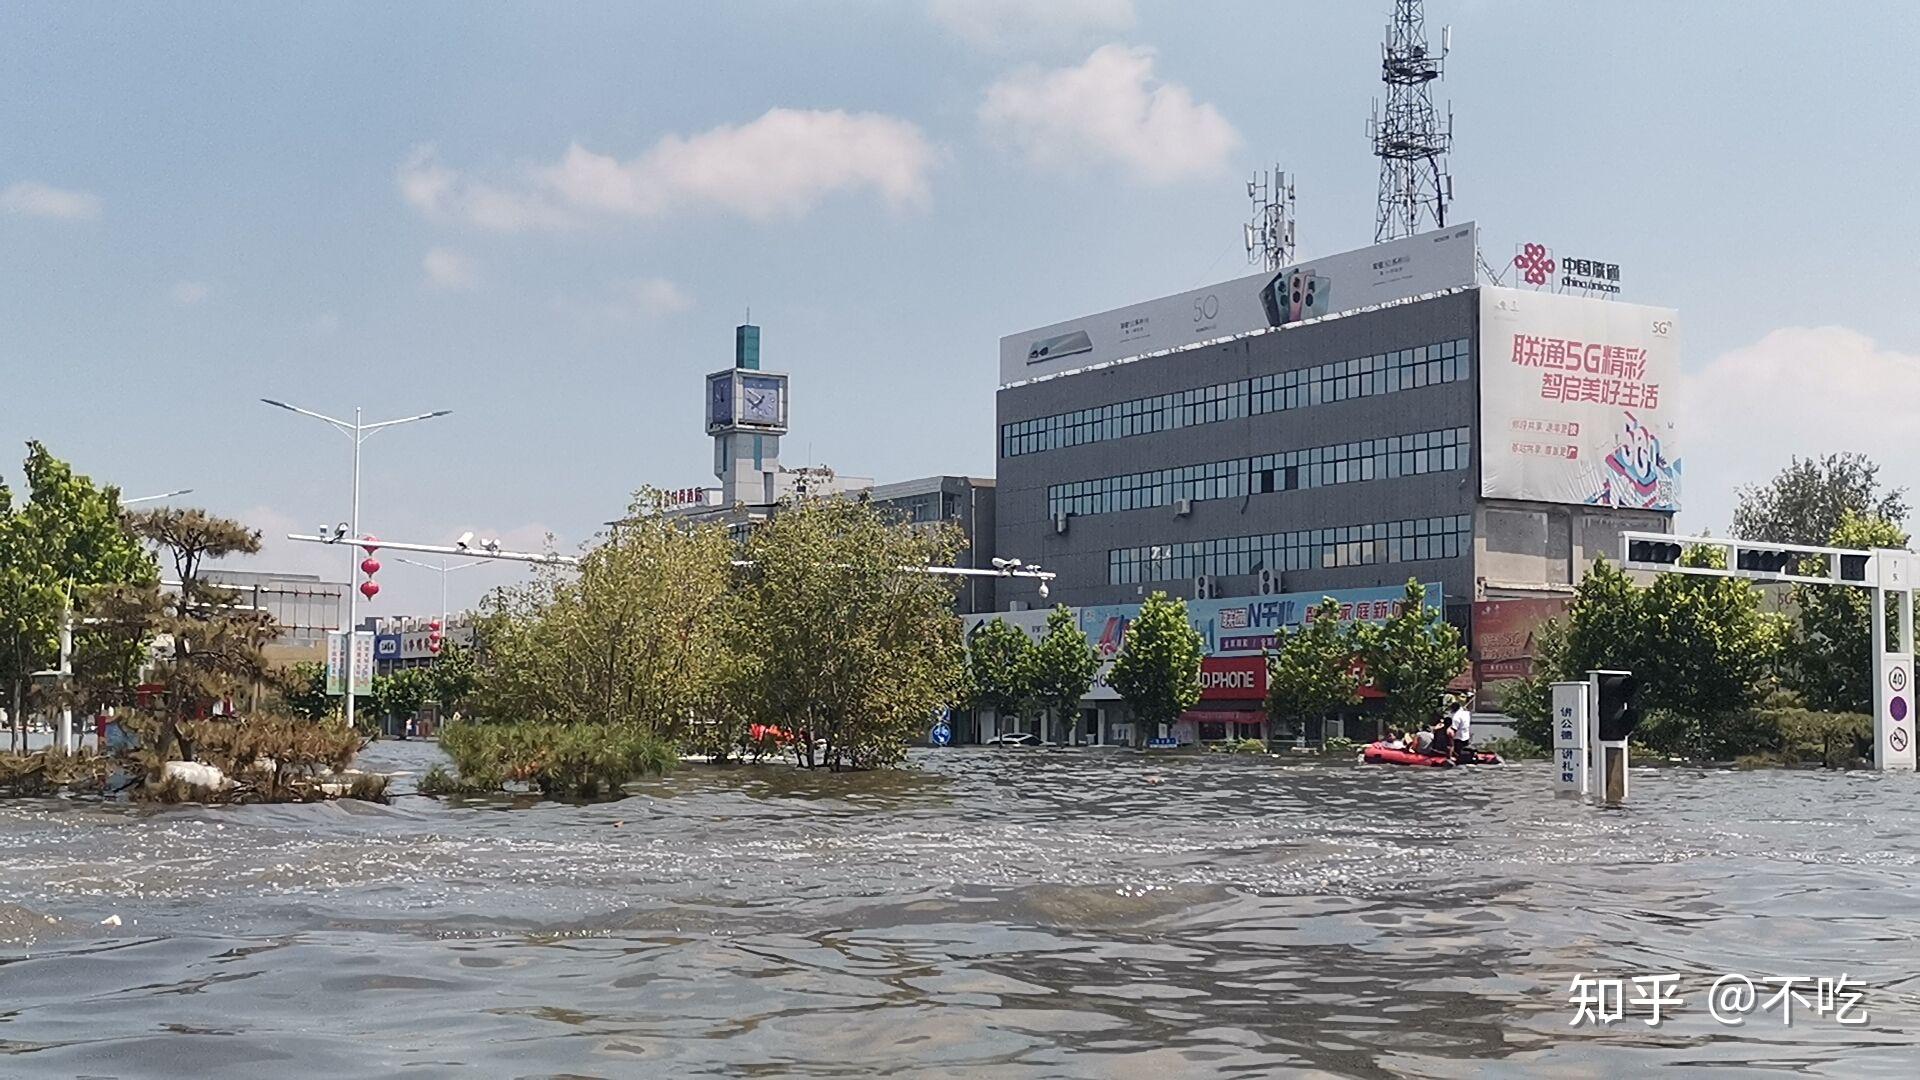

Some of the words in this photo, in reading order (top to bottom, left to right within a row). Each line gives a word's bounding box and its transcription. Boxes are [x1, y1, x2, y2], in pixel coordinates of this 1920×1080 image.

[1562, 257, 1620, 281] 中国联通
[1512, 333, 1647, 380] 联通5G精彩
[1541, 372, 1659, 410] 智启美好生活
[1892, 674, 1903, 685] 40
